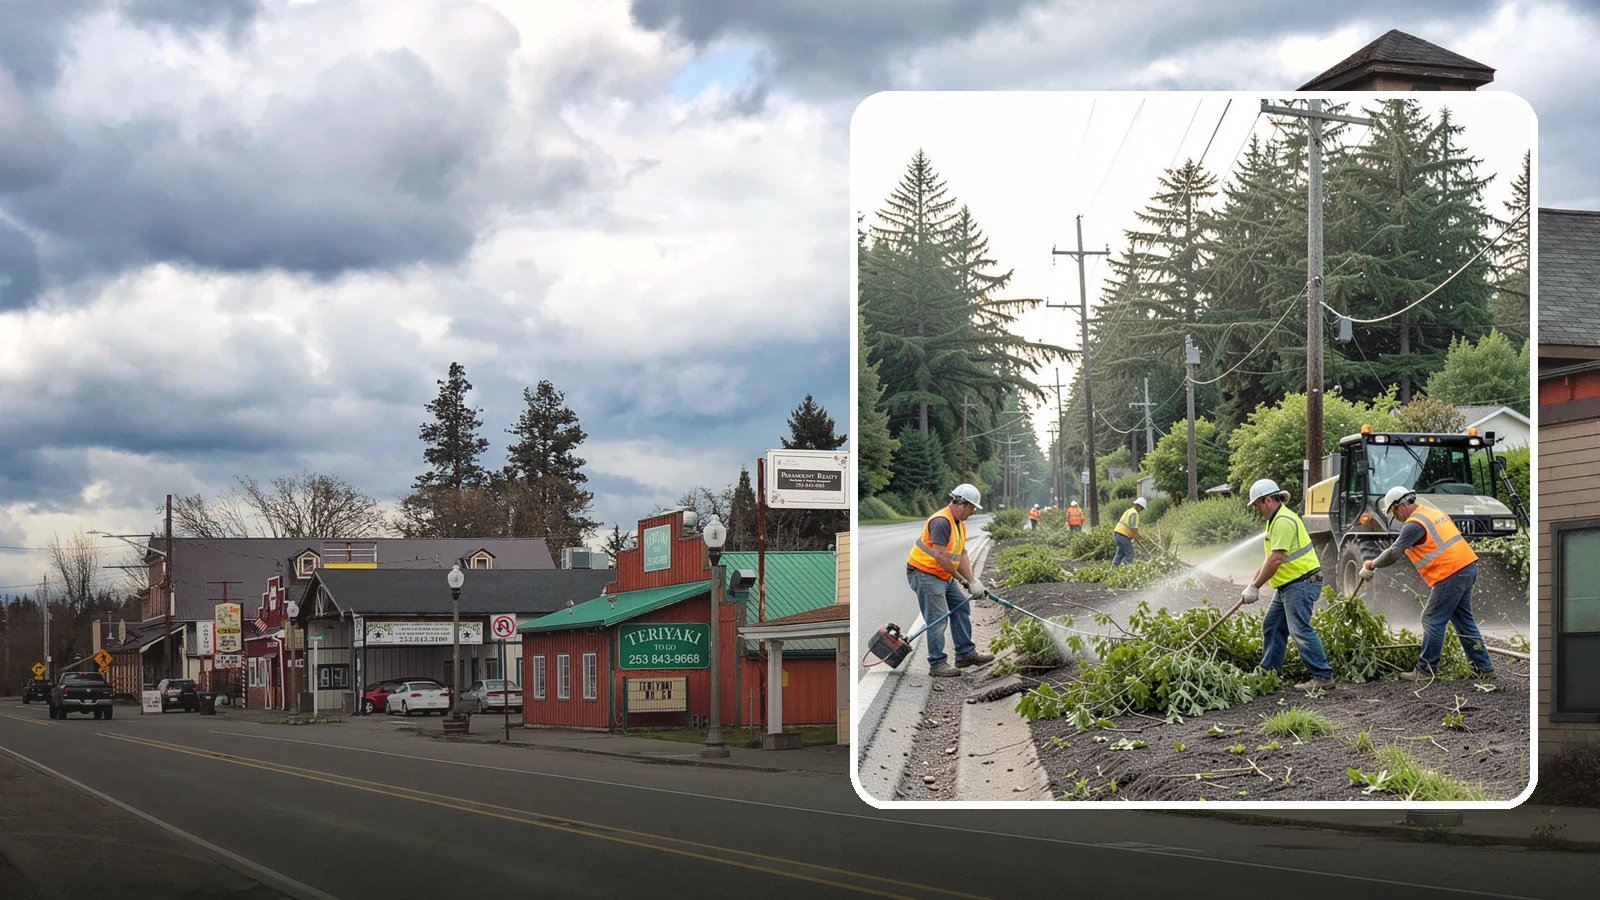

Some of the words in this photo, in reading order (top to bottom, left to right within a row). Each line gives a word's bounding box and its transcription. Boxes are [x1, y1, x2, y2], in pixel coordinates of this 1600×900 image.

[781, 471, 815, 479] PARAMOUNT
[817, 472, 839, 480] REALTY
[624, 627, 702, 646] TERIYAKI
[628, 654, 648, 664] 253
[651, 653, 700, 664] 843-9668
